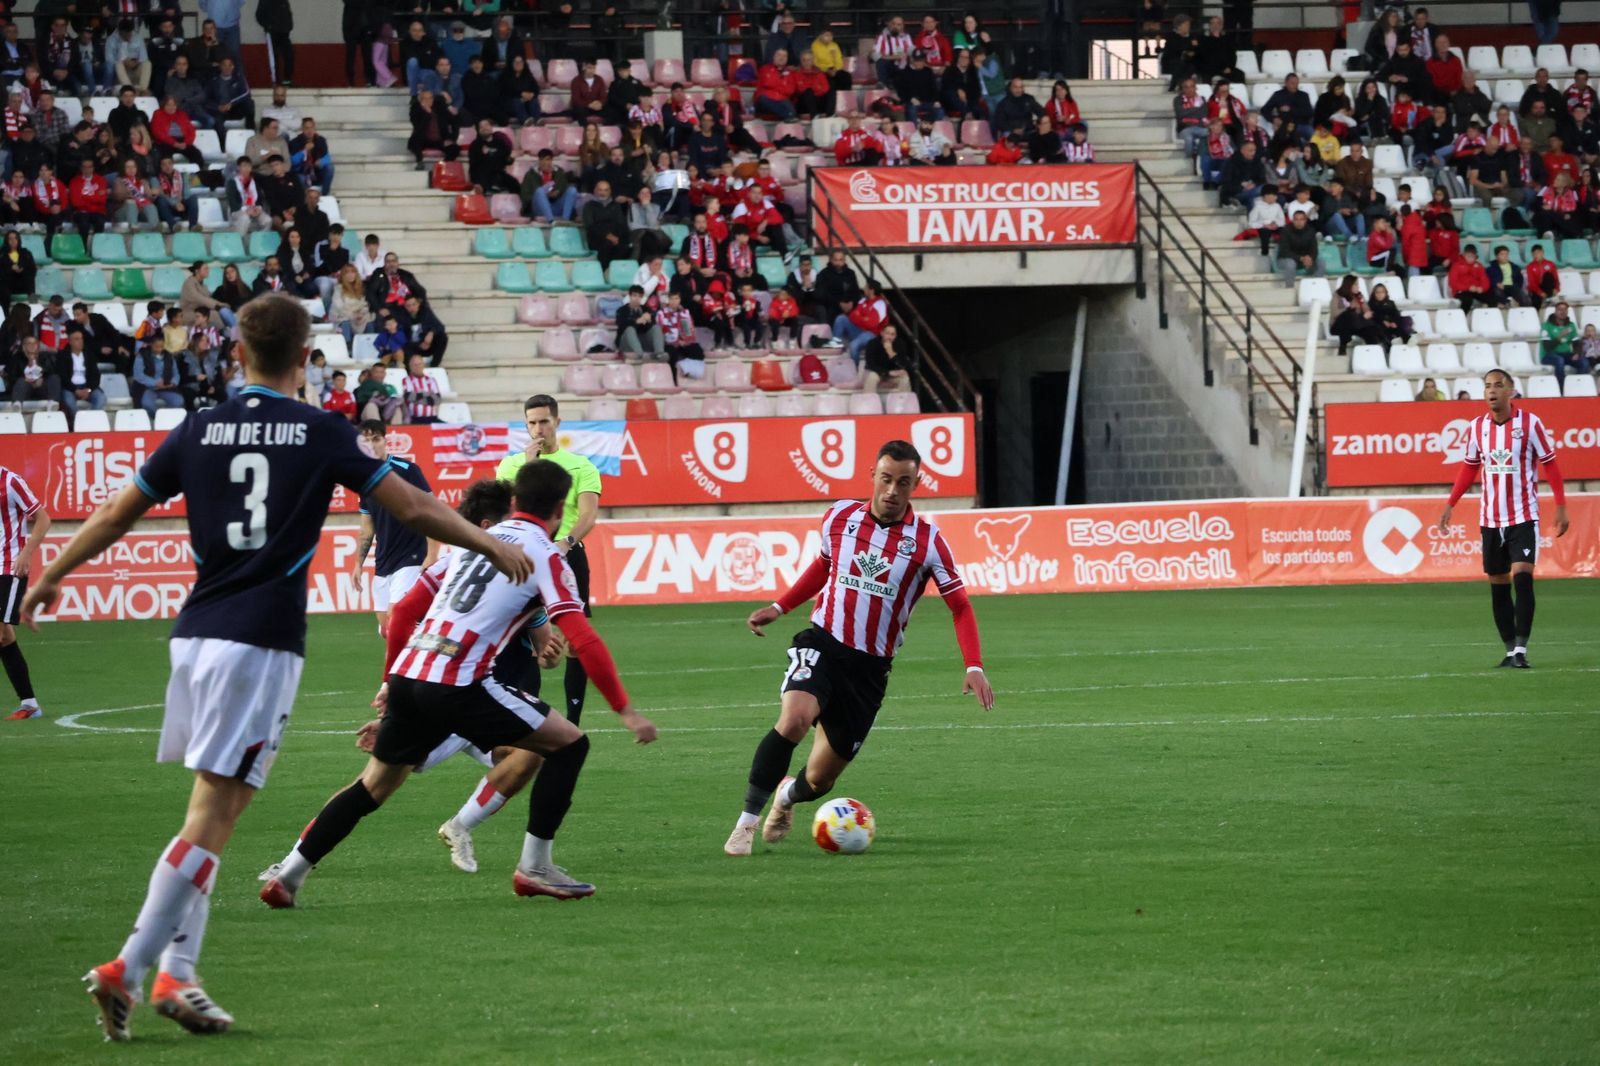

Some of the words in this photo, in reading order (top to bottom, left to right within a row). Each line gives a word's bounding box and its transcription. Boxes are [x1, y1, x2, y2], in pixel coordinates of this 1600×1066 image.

[1065, 224, 1101, 242] S.A.
[200, 422, 237, 445] JON
[238, 422, 262, 445] DE
[264, 422, 308, 445] LUIS
[681, 451, 722, 499] ZAMORA
[789, 448, 830, 496] ZAMORA
[226, 452, 270, 551] 3
[1066, 511, 1235, 548] Escuela
[1261, 528, 1314, 543] Escucha
[1316, 527, 1352, 542] todos
[1263, 550, 1281, 564] los
[1283, 550, 1335, 567] partidos
[1336, 552, 1353, 564] en
[1429, 540, 1482, 556] ZAMOR
[1072, 548, 1237, 584] infantil
[437, 549, 500, 615] 18
[838, 574, 861, 588] CAJA
[863, 581, 896, 598] RURAL
